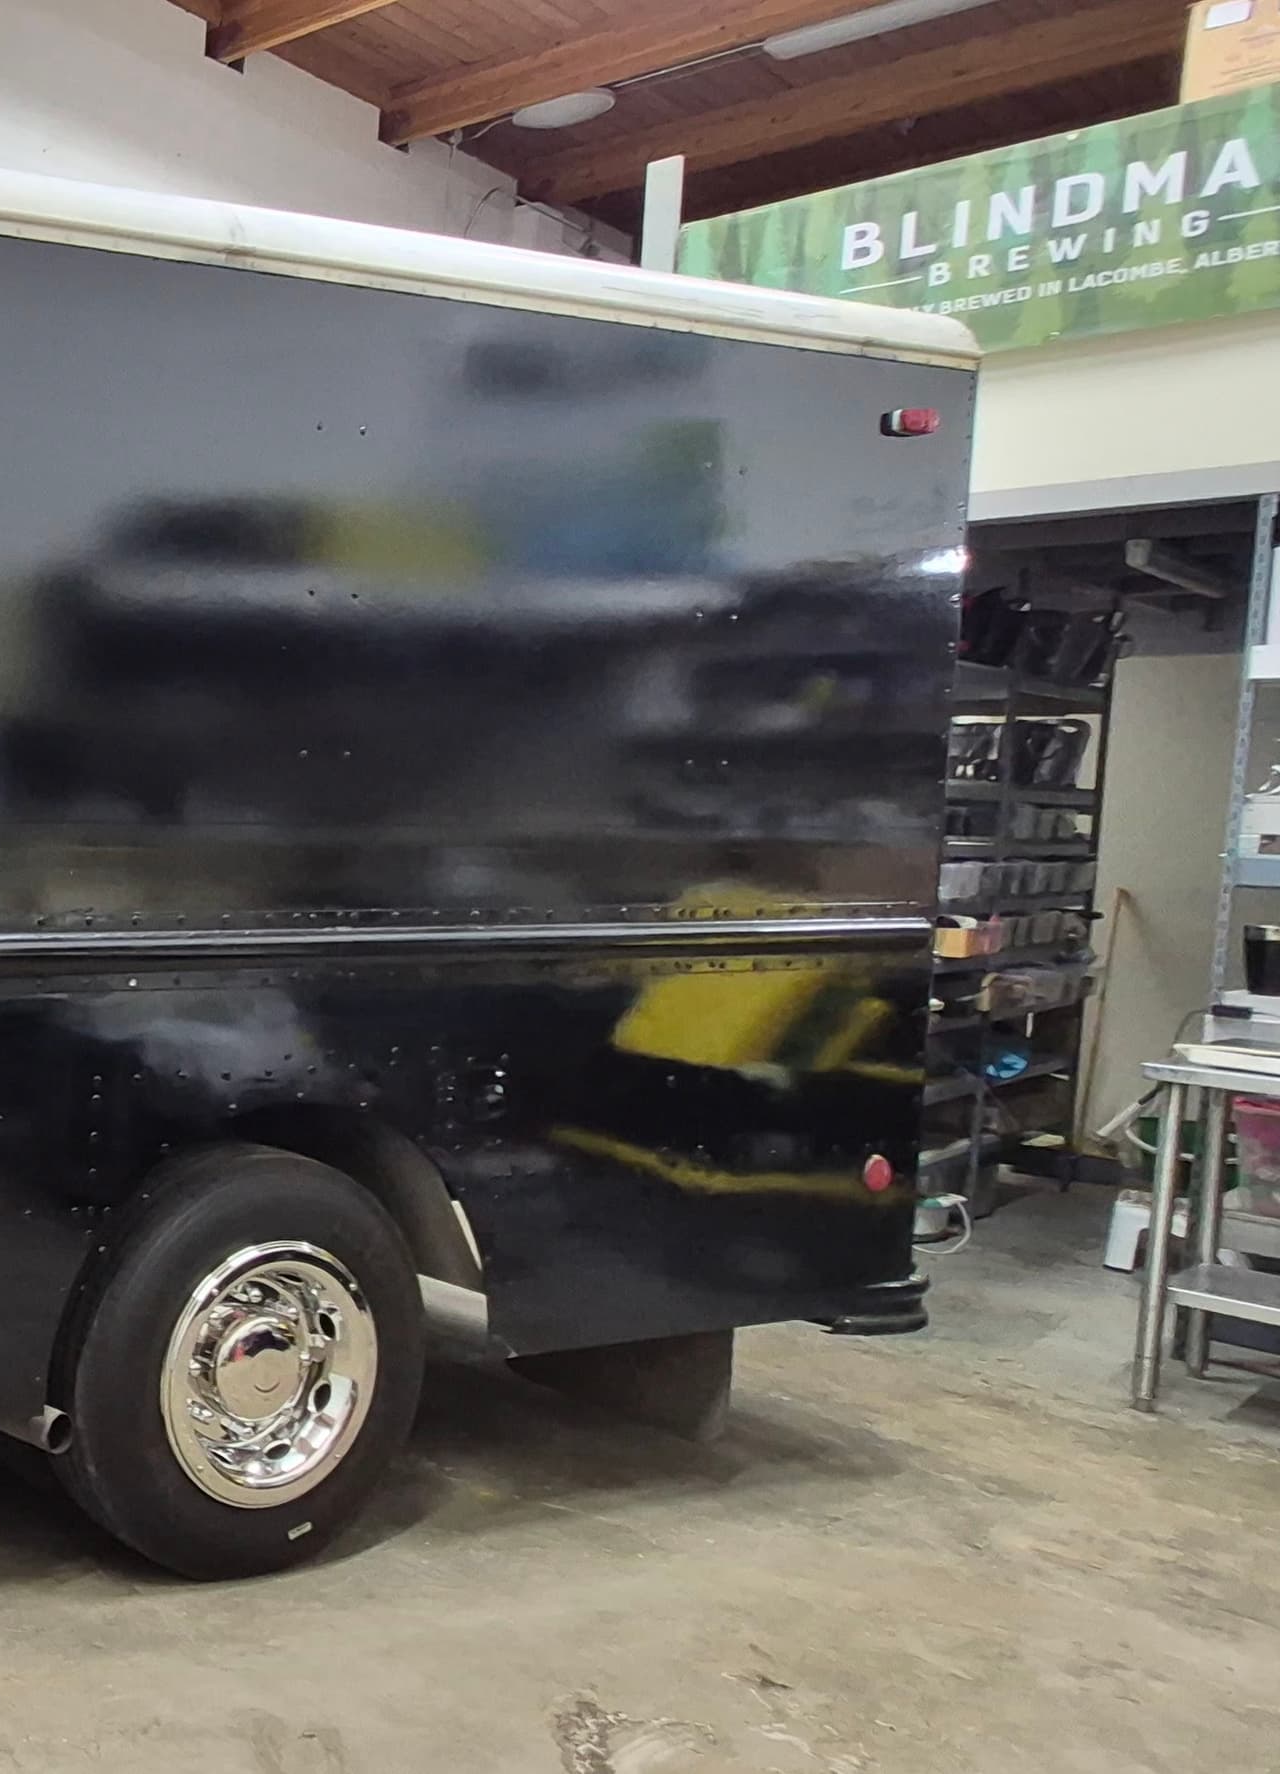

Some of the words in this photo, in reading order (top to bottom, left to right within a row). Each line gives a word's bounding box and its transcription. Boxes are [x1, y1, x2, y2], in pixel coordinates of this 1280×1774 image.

[841, 138, 1261, 270] BLINDMA
[928, 210, 1210, 287] BREWING
[940, 285, 1032, 315] BREWED
[1037, 279, 1063, 298] IN
[1068, 256, 1188, 292] LACOMBE,
